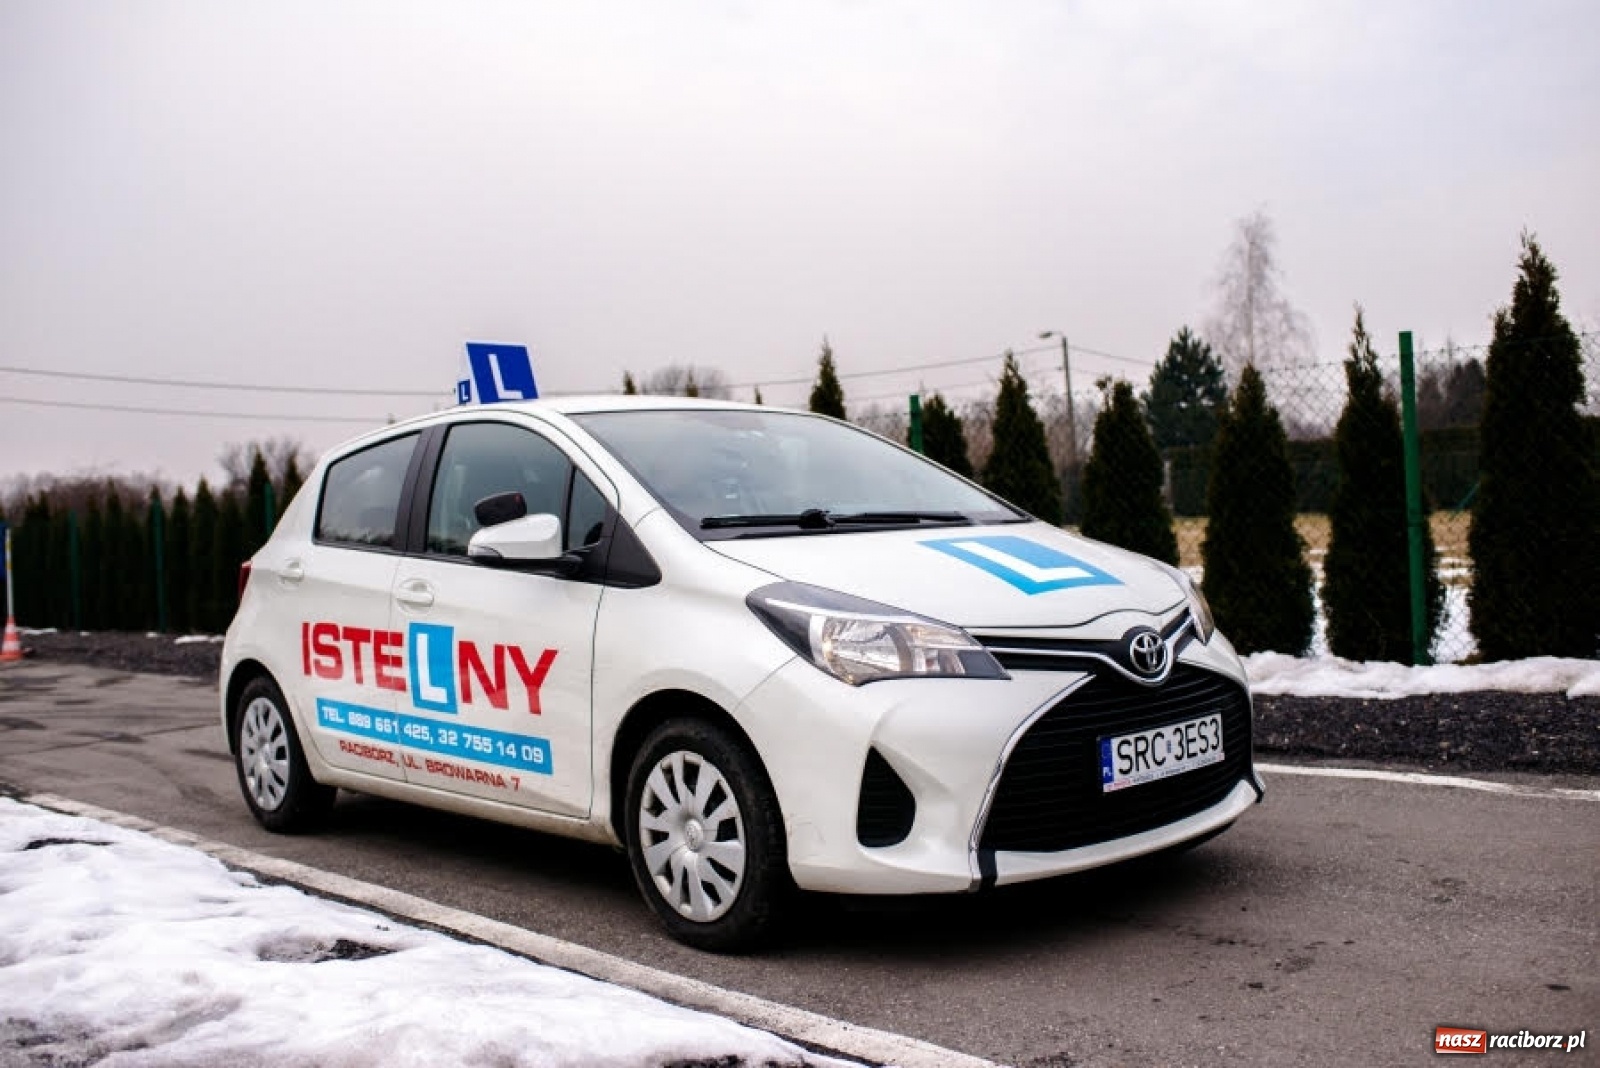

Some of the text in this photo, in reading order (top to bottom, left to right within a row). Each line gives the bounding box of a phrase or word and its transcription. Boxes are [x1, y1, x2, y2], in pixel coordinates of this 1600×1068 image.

[461, 383, 469, 402] L
[487, 353, 524, 400] L
[950, 541, 1096, 582] L
[302, 621, 558, 716] ISTELNY
[438, 728, 458, 746] 32
[462, 733, 493, 753] 755
[496, 740, 516, 759] 14
[521, 745, 544, 764] 09
[1117, 731, 1166, 775] SRC
[1173, 718, 1220, 761] 3ES3
[425, 759, 507, 789] BROWARNA
[511, 775, 520, 791] 7
